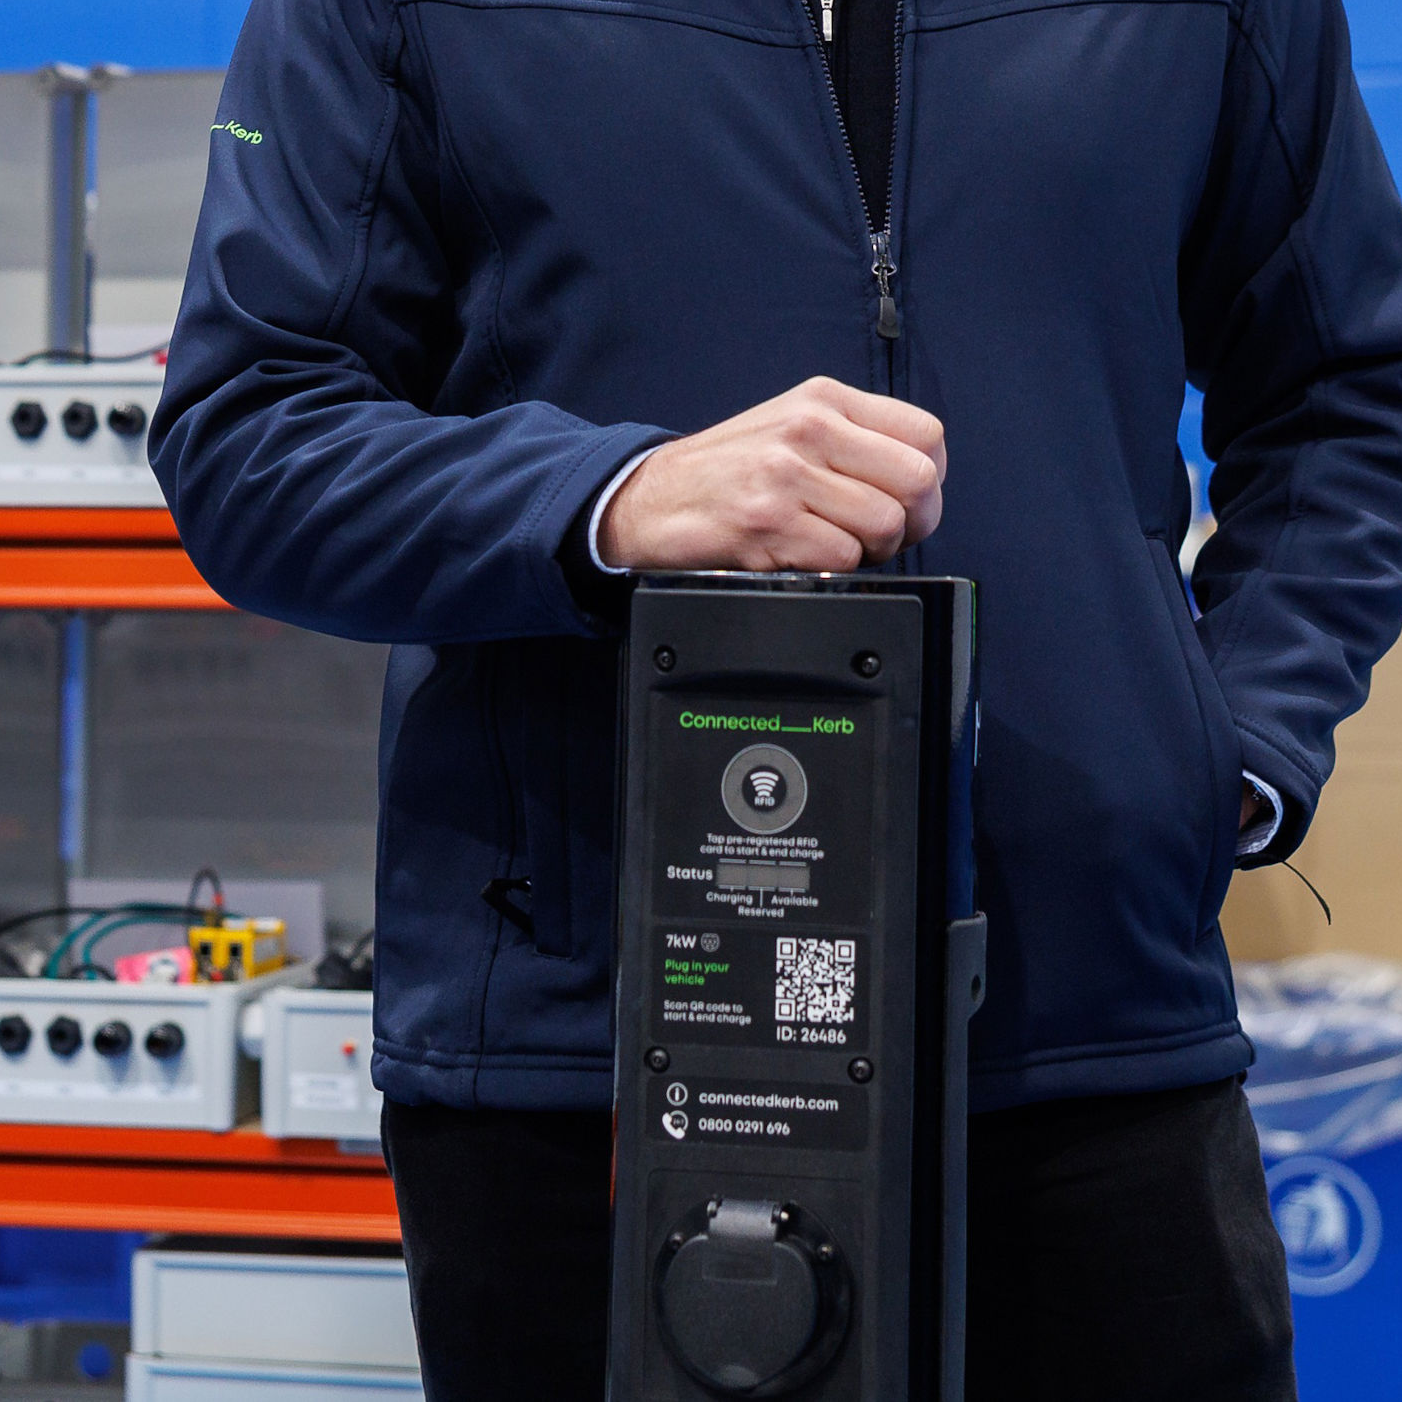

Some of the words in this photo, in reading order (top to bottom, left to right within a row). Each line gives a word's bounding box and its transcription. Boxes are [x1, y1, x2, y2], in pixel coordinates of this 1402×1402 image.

[224, 119, 263, 145] Kerb
[679, 711, 781, 731] Connected
[812, 716, 855, 735] Kerb
[753, 797, 776, 807] RFID
[706, 833, 725, 845] Tap
[726, 835, 795, 847] pre-registered
[796, 837, 819, 848] RFID
[700, 844, 723, 854] card
[725, 845, 735, 855] to
[736, 846, 760, 856] start
[761, 847, 768, 856] &
[769, 847, 788, 858] end
[789, 847, 825, 861] charge
[667, 865, 713, 881] Status
[705, 891, 754, 905] Charging
[770, 894, 819, 907] Available
[737, 905, 785, 918] Reserved
[665, 933, 697, 949] 7kW
[665, 958, 690, 974] Plug
[691, 960, 703, 972] in
[704, 962, 731, 975] your
[664, 973, 706, 986] vehicle
[663, 999, 689, 1011] Scan
[690, 1000, 705, 1012] QR
[705, 1001, 731, 1013] code
[732, 1002, 744, 1014] to
[663, 1011, 687, 1022] start
[688, 1012, 695, 1022] &
[696, 1012, 716, 1023] end
[716, 1013, 752, 1026] charge
[776, 1025, 797, 1042] ID:
[800, 1027, 847, 1044] 26486
[698, 1092, 839, 1112] connectedkerb.com
[698, 1117, 733, 1133] 0800
[734, 1119, 764, 1134] 0291
[766, 1121, 791, 1136] 696
